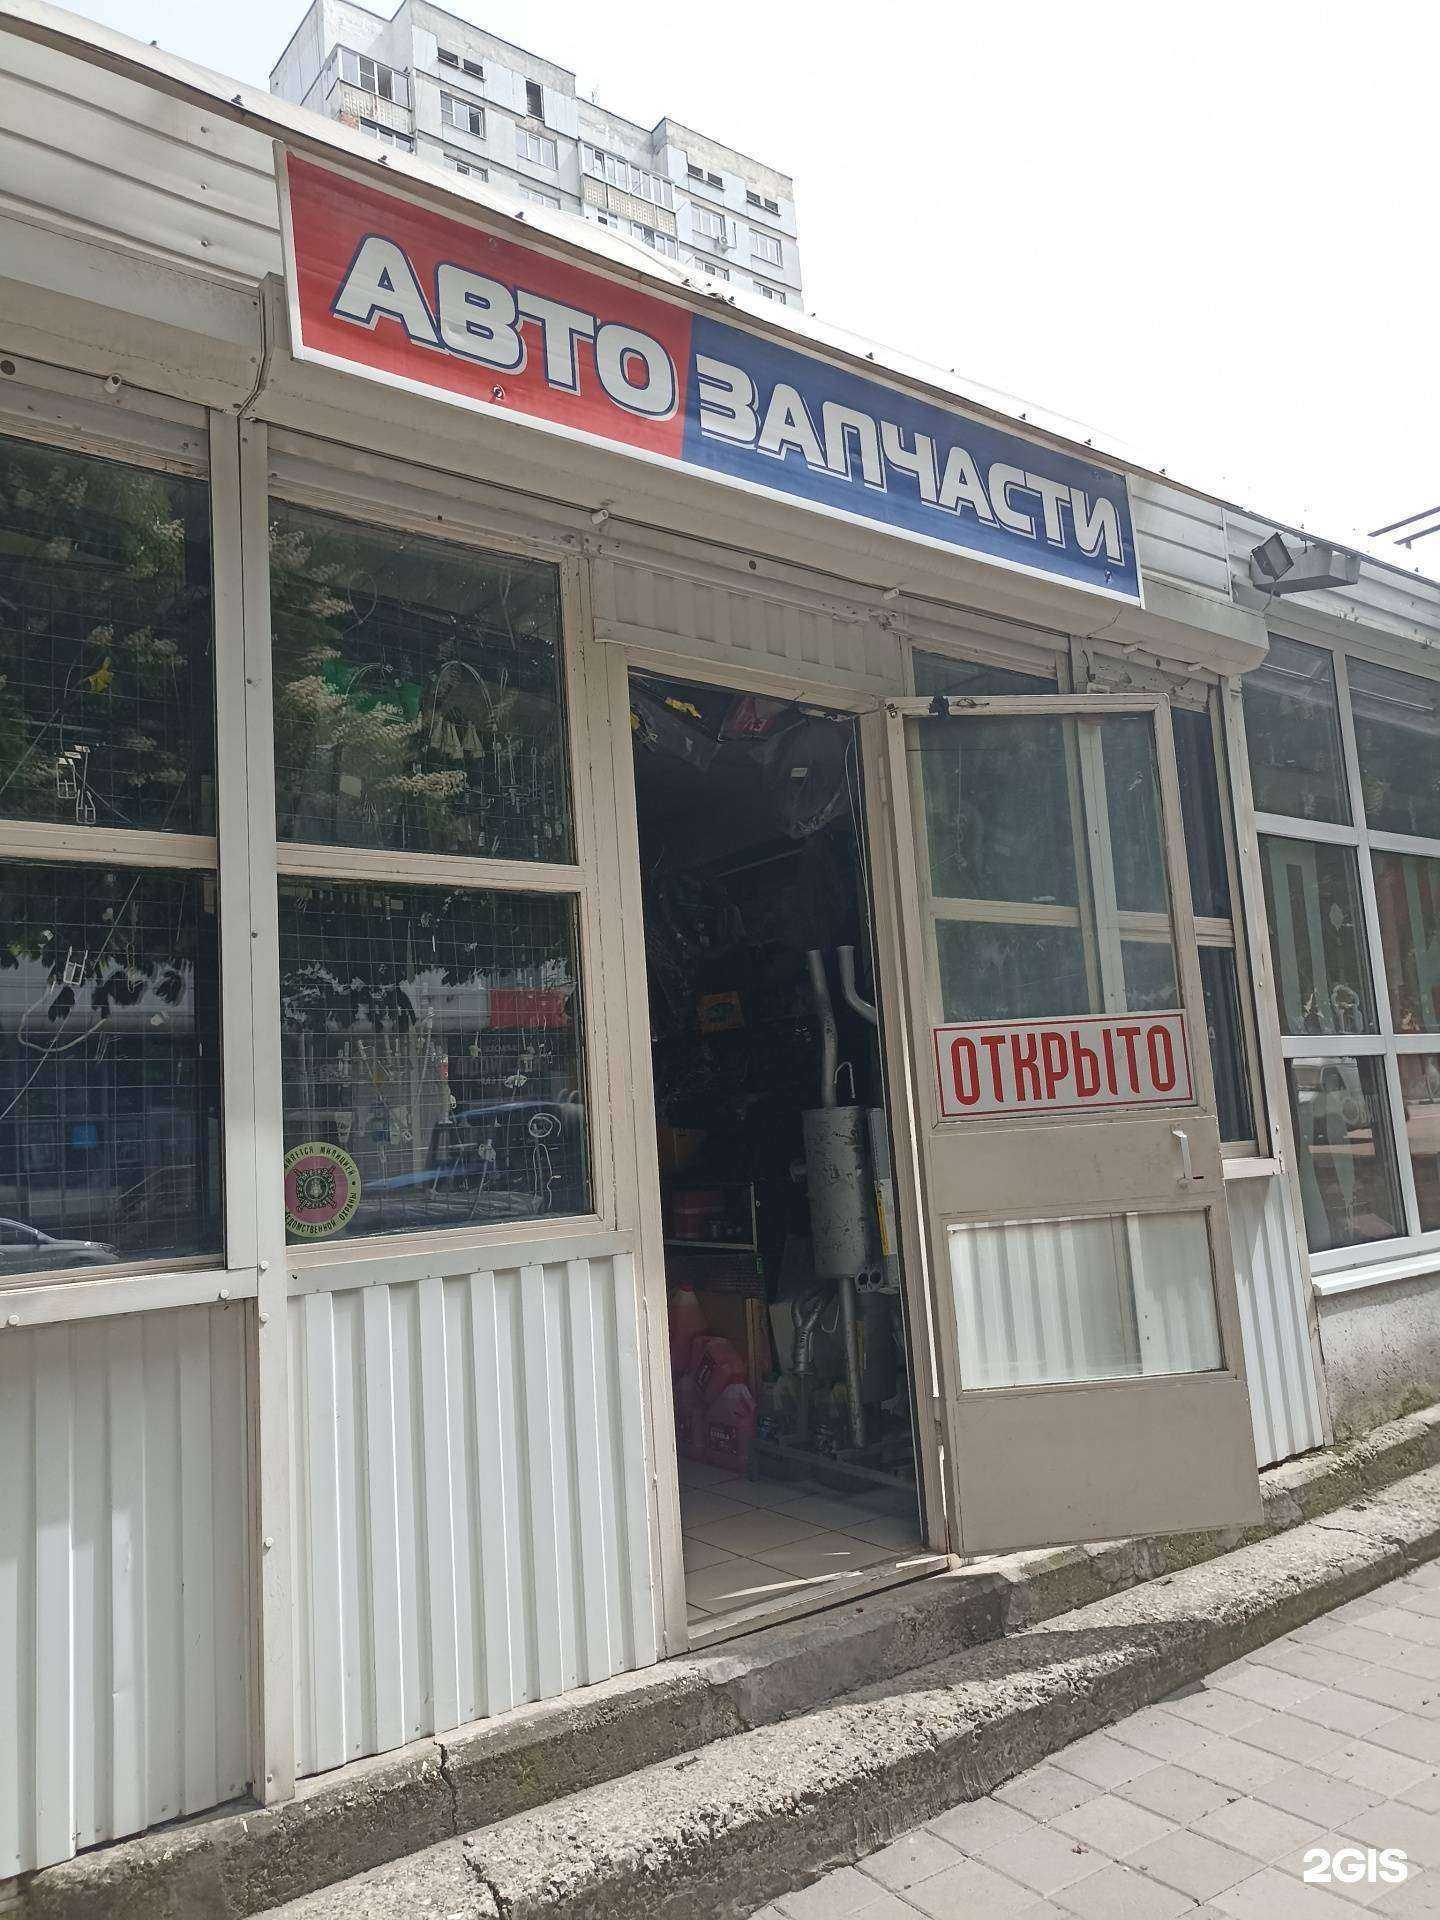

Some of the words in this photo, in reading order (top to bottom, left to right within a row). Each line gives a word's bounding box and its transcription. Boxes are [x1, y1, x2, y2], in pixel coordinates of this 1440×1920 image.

[331, 233, 679, 421] АВТО
[695, 354, 1126, 566] ЗАПЧАСТИ
[951, 1024, 1176, 1106] ОТКРЫТО
[320, 1146, 354, 1176] МИЛИЦИЕЙ
[338, 1192, 357, 1221] ОХРАНЫ
